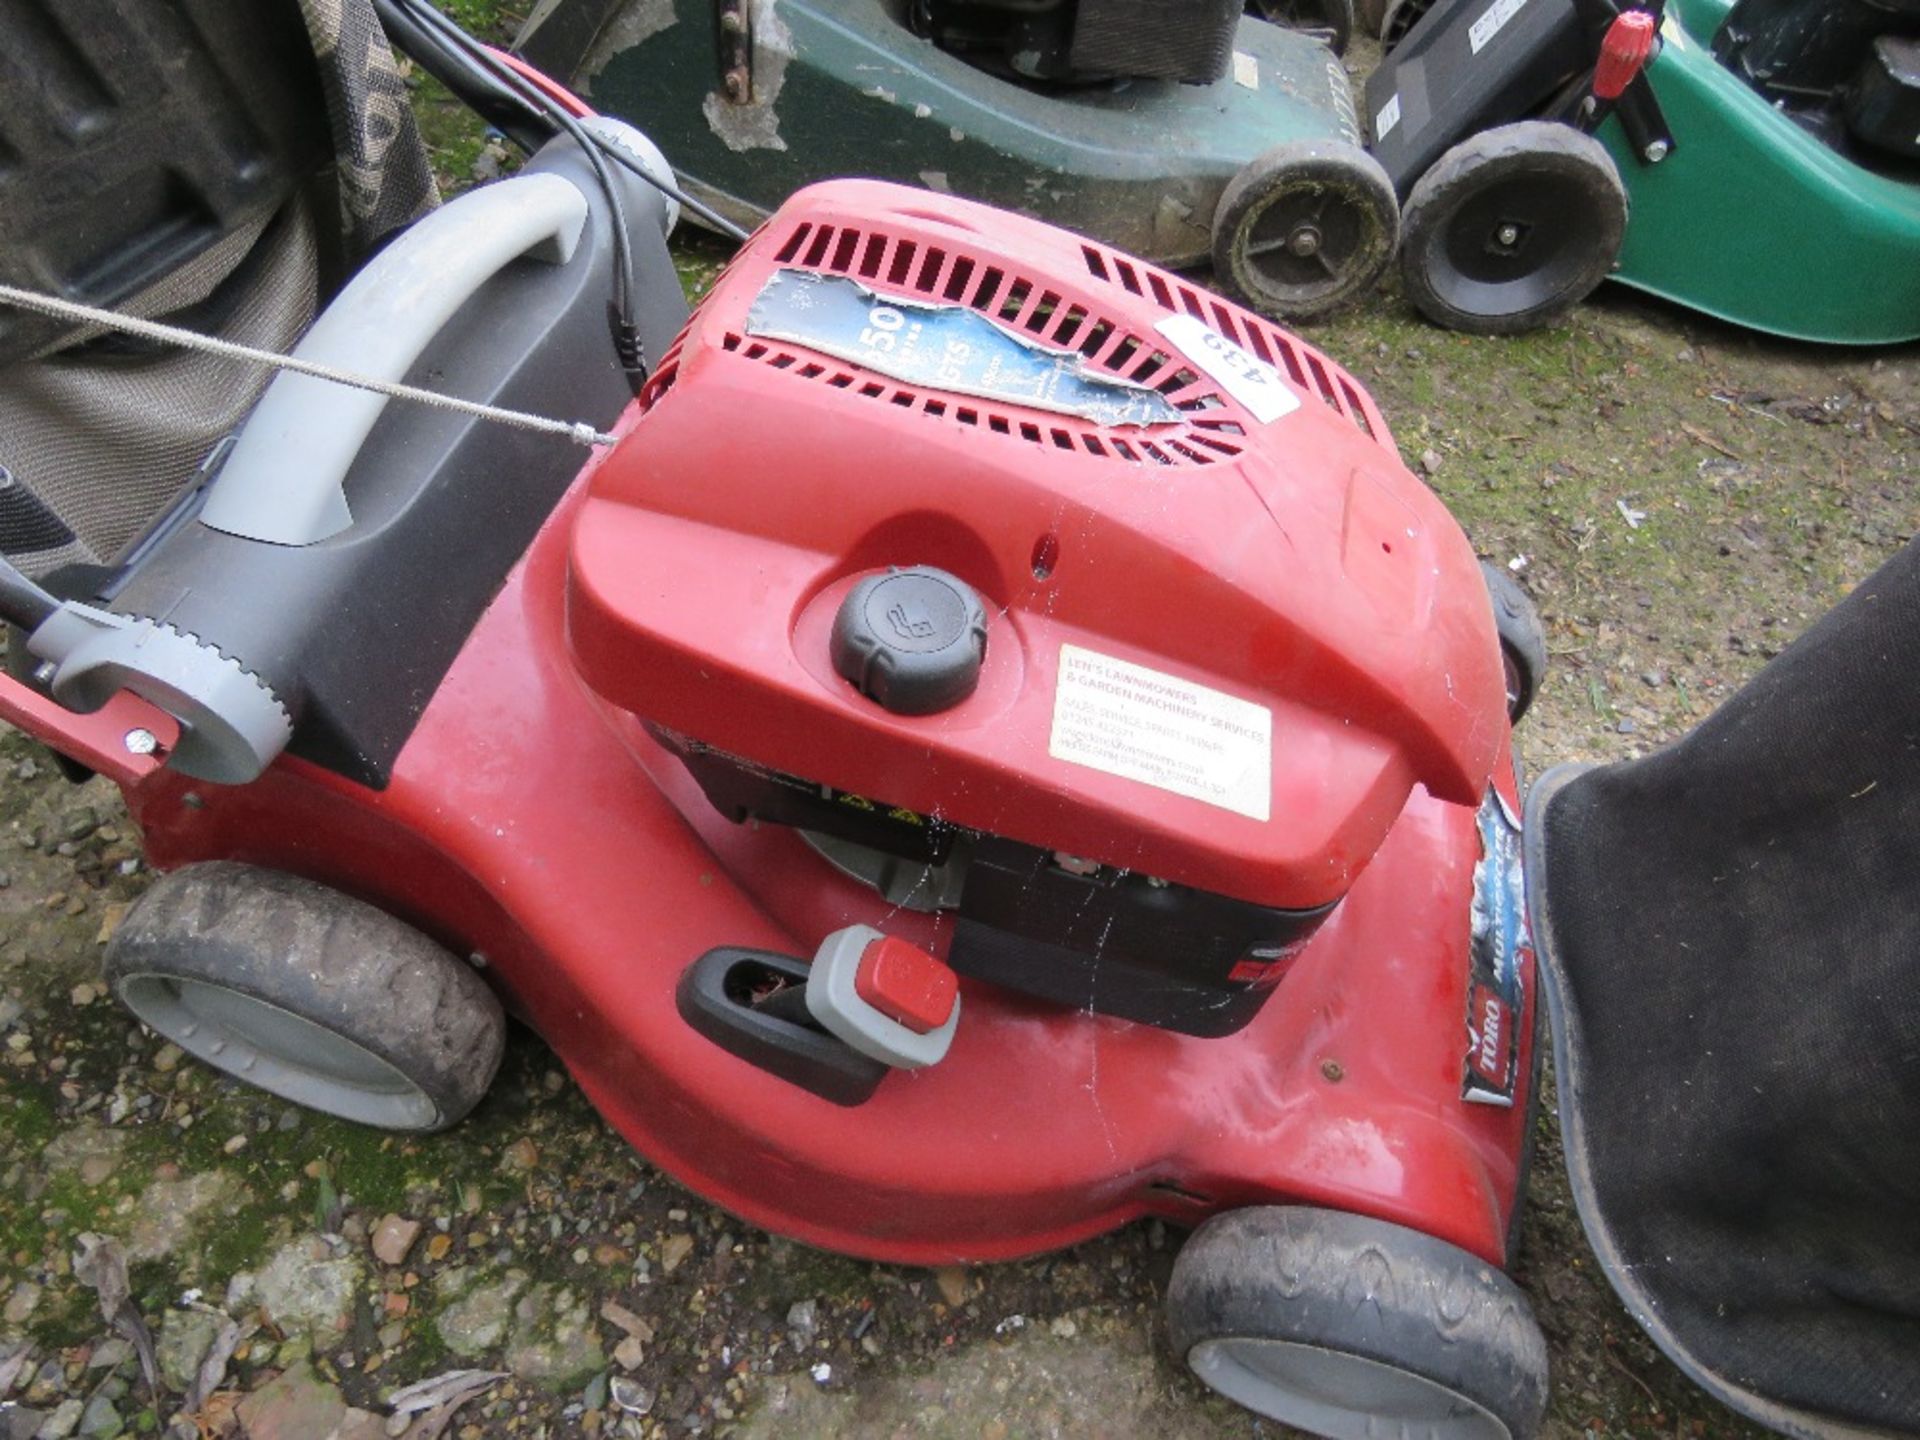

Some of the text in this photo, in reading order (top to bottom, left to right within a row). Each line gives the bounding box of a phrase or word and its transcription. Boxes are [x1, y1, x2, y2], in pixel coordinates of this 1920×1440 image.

[1203, 333, 1266, 384] 439
[1067, 655, 1197, 705] LEN'S LAWNMOWERS
[1077, 673, 1131, 699] GARDEN
[1134, 691, 1206, 723] MACHINERY
[1208, 715, 1264, 744] SERVICES
[1481, 1000, 1499, 1072] TORO
